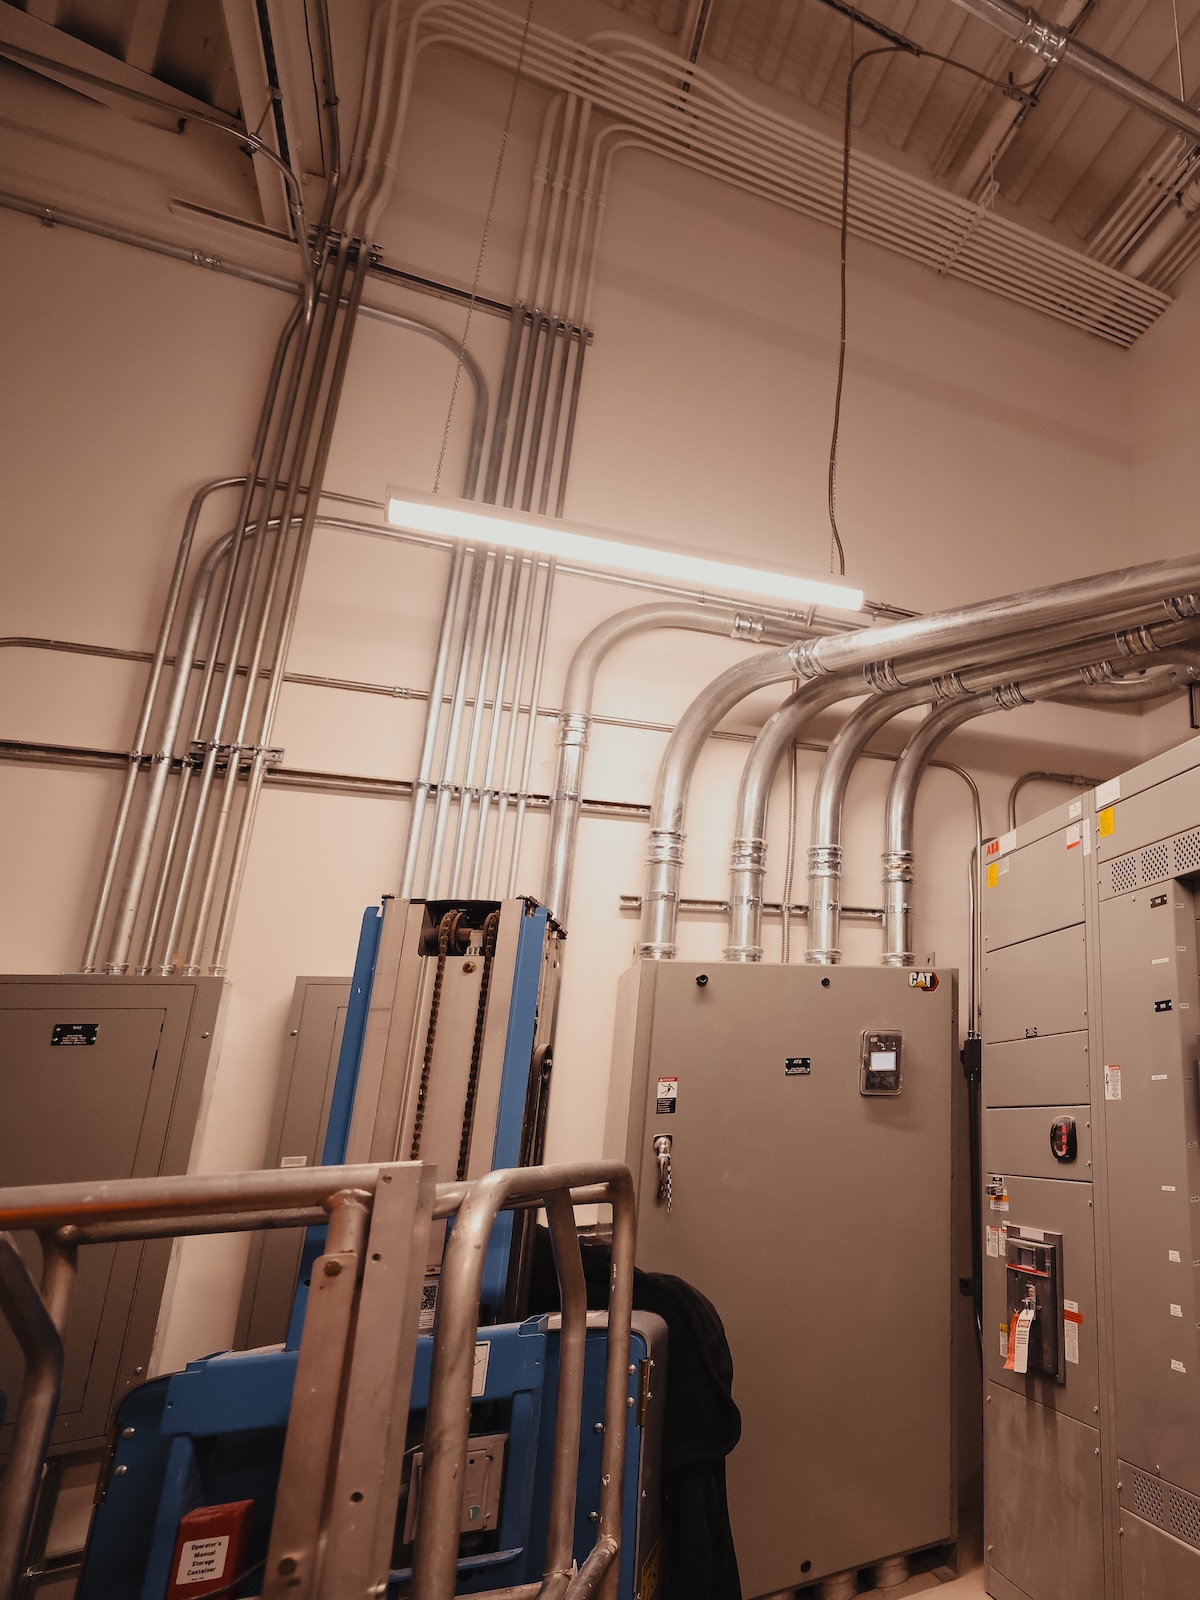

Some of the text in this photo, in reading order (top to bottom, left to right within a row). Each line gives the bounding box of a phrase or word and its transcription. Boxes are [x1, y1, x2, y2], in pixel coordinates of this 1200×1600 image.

[986, 840, 999, 857] ABB
[908, 971, 933, 988] CAT
[191, 1541, 222, 1551] Operator's
[193, 1550, 217, 1558] Manual
[191, 1559, 215, 1567] Storage
[187, 1567, 217, 1576] Container
